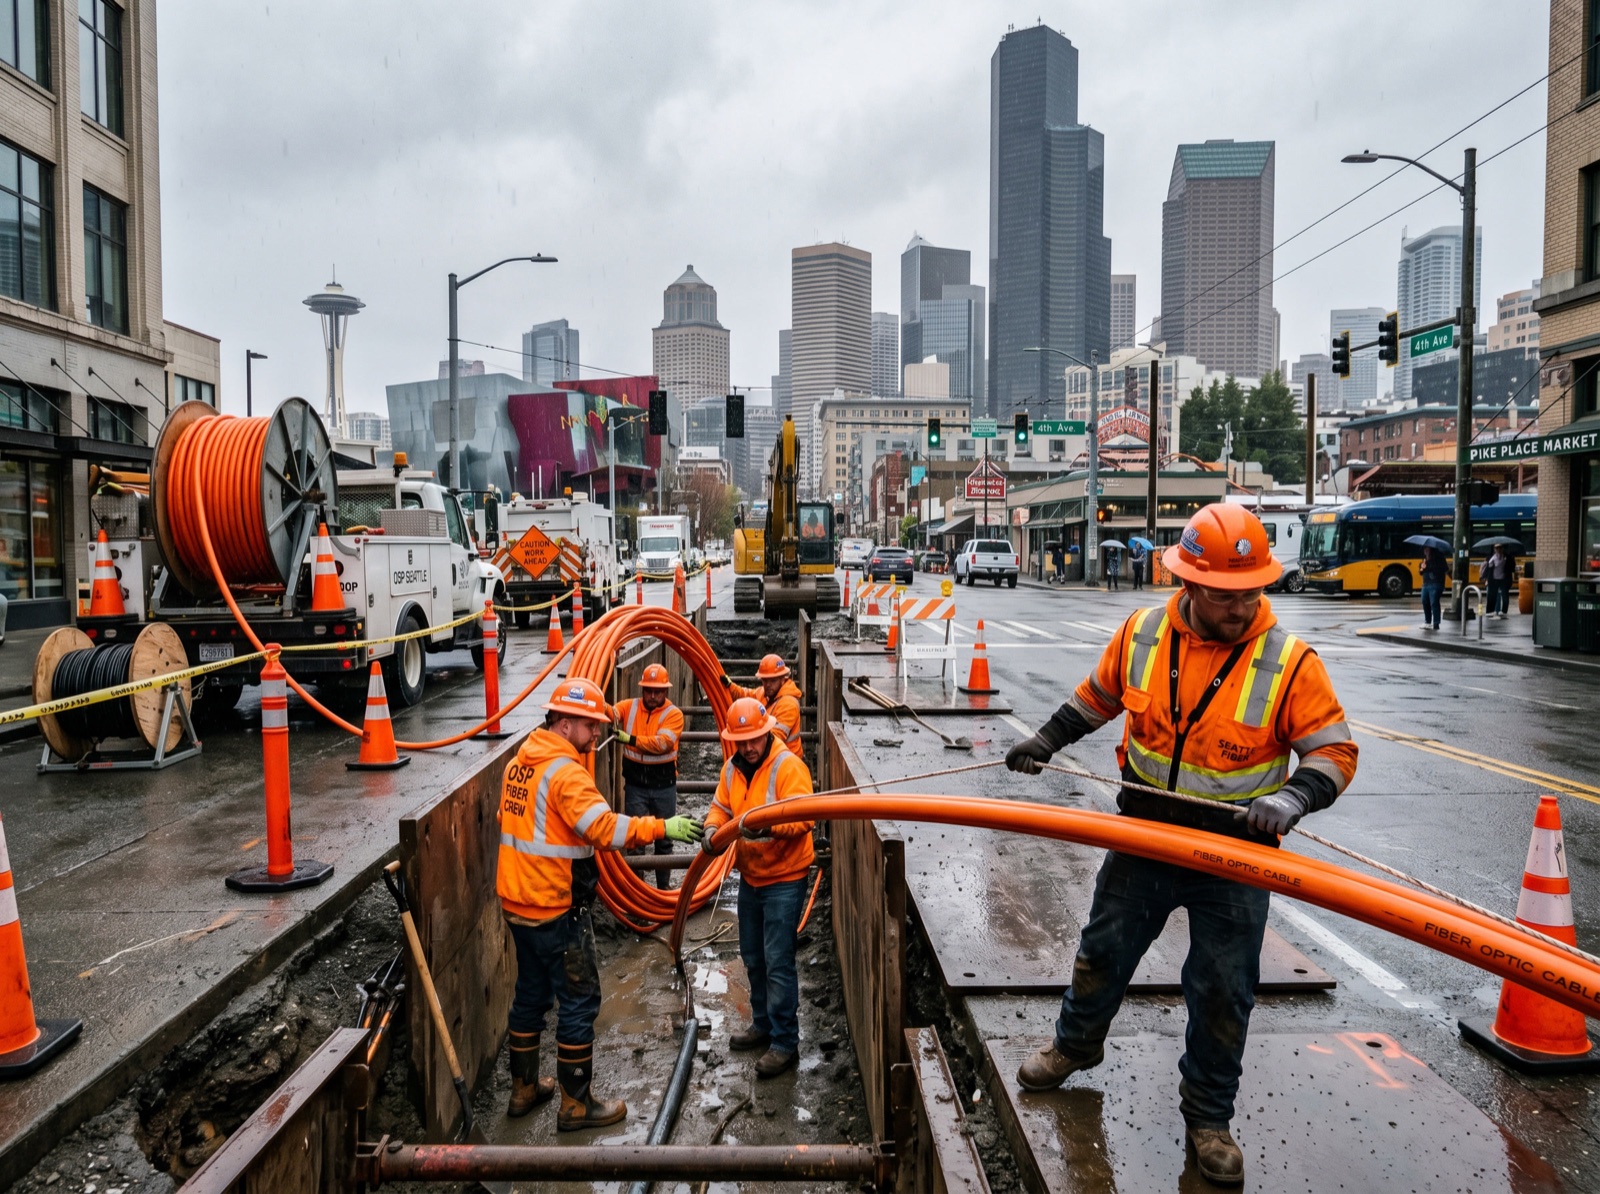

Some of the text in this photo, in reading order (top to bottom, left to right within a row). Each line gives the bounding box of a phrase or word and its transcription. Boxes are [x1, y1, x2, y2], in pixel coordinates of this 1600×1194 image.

[1414, 335, 1448, 351] 4th Ave
[1038, 424, 1052, 432] 4th
[1470, 433, 1598, 460] PIKE PLACE MARKET
[520, 540, 550, 549] CAUTION
[524, 549, 545, 557] WORK
[524, 557, 548, 566] AHEAD
[393, 569, 428, 584] OSP SEATTLE
[508, 764, 535, 784] OSP
[506, 783, 528, 802] FIBER
[504, 799, 525, 817] CREW
[1193, 849, 1302, 888] FIBER OPTIC CABLE
[1424, 921, 1472, 949] FIBER
[1479, 944, 1534, 974] OPTIC
